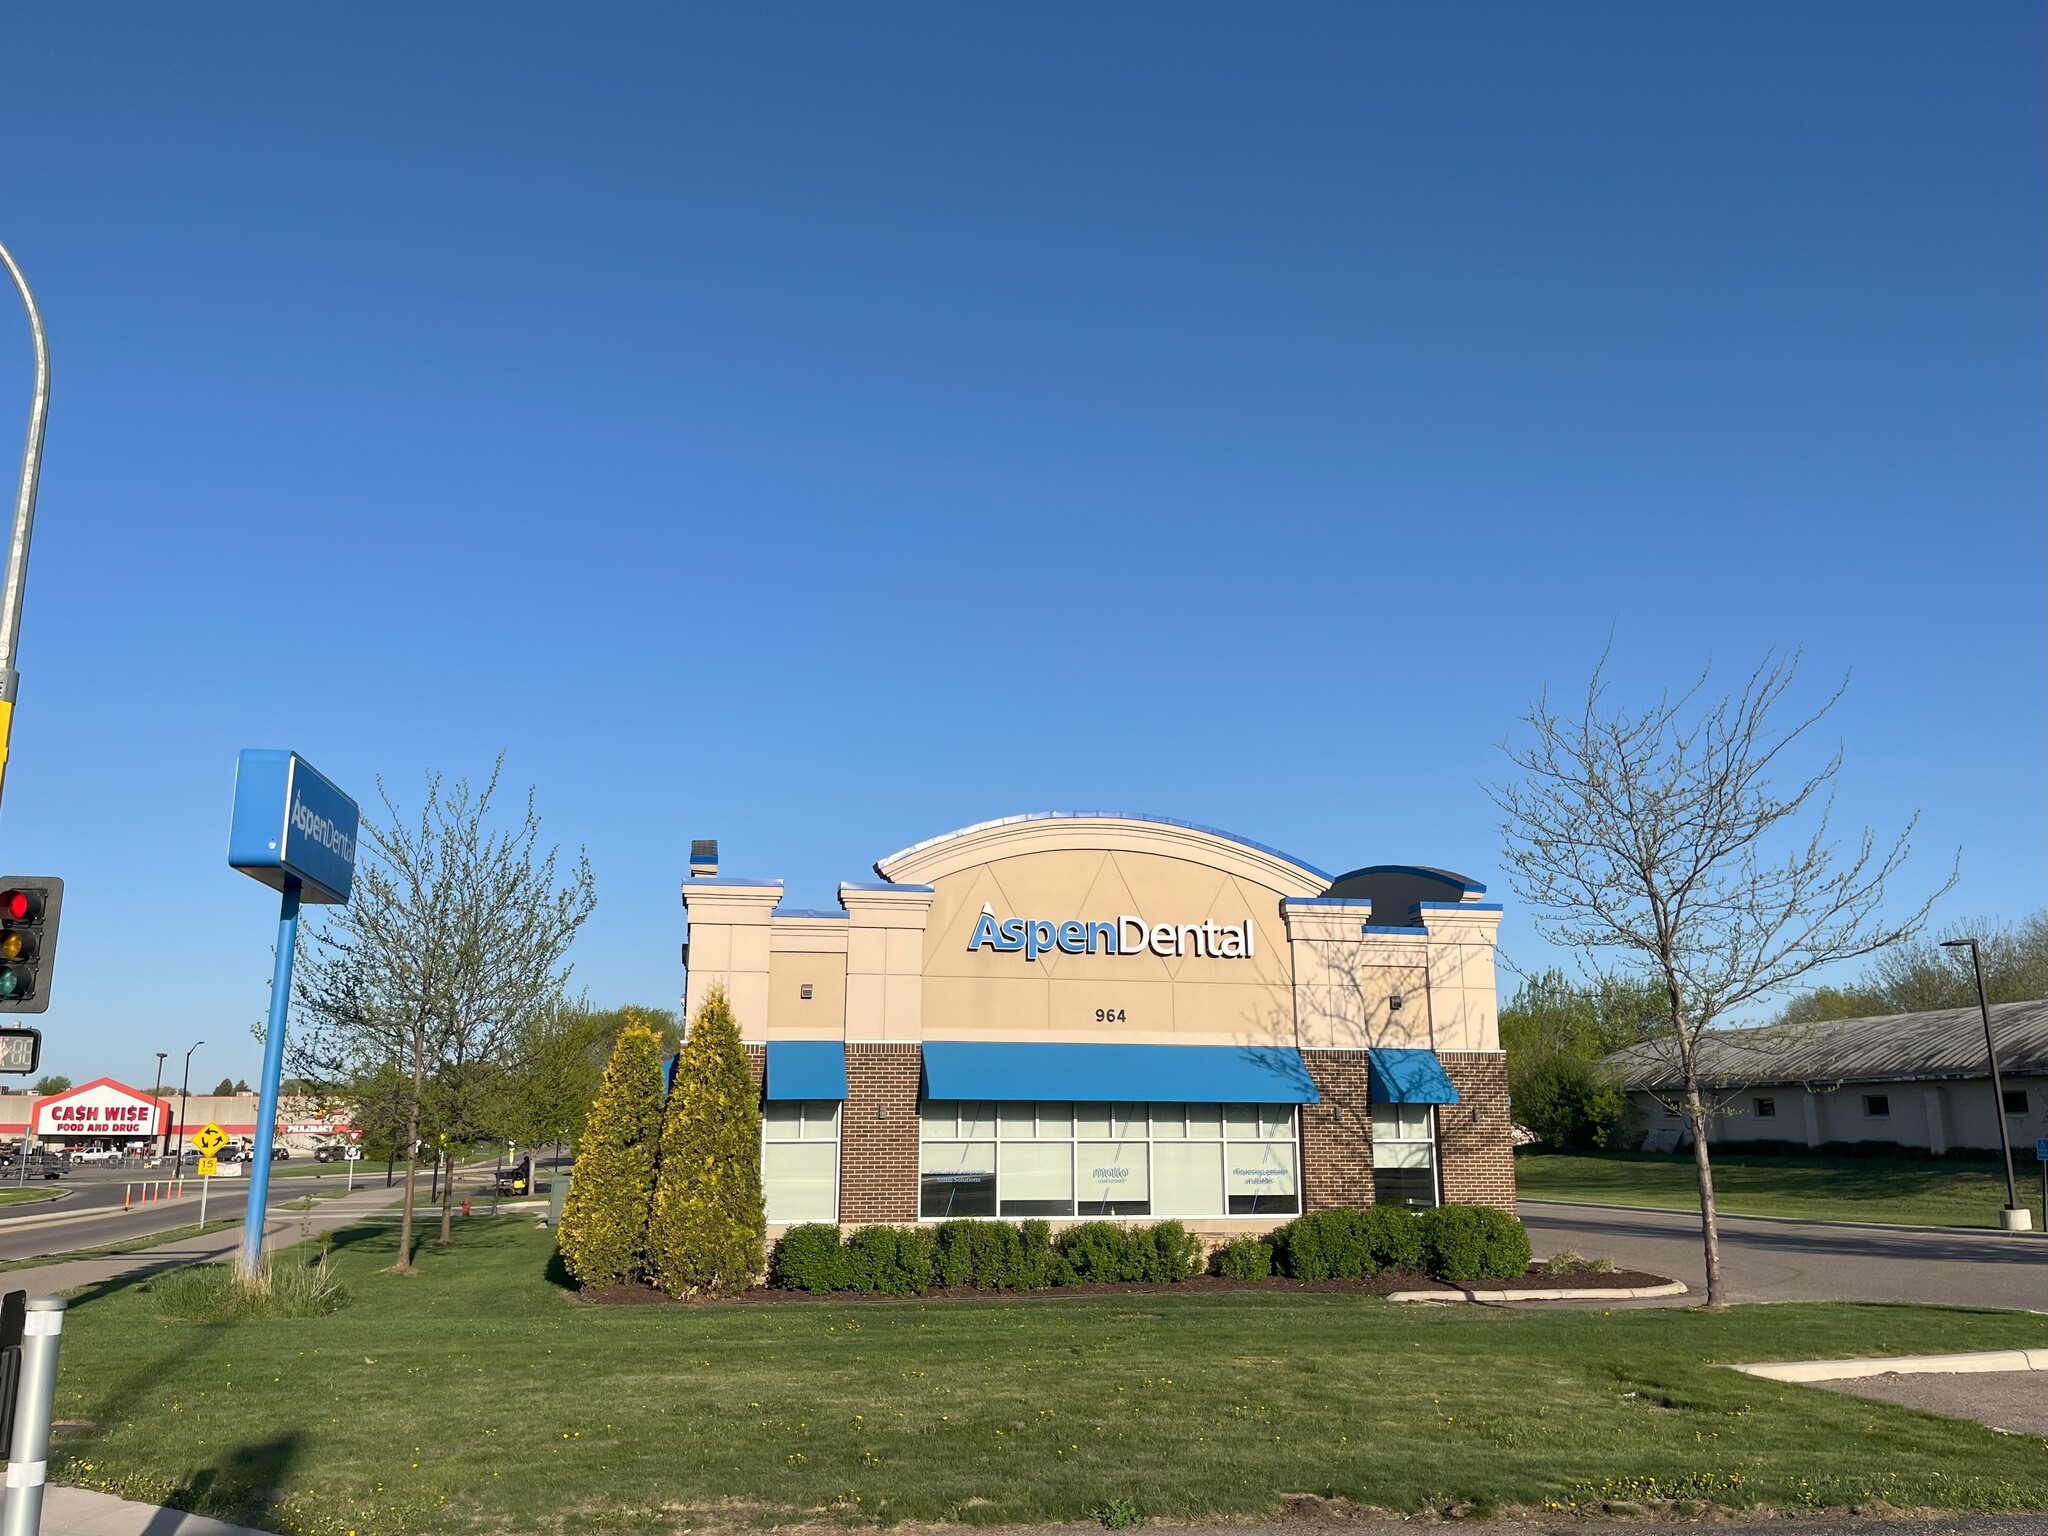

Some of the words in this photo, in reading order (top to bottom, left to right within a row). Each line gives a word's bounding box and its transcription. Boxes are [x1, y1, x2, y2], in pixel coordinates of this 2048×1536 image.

[291, 788, 354, 865] AspenDental
[967, 901, 1255, 961] AspenDental
[1095, 1008, 1127, 1023] 964
[57, 1123, 84, 1132] FOOD
[87, 1123, 109, 1132] AND
[112, 1123, 140, 1132] DRUG
[287, 1124, 334, 1133] PHARMACY
[202, 1160, 214, 1169] 15
